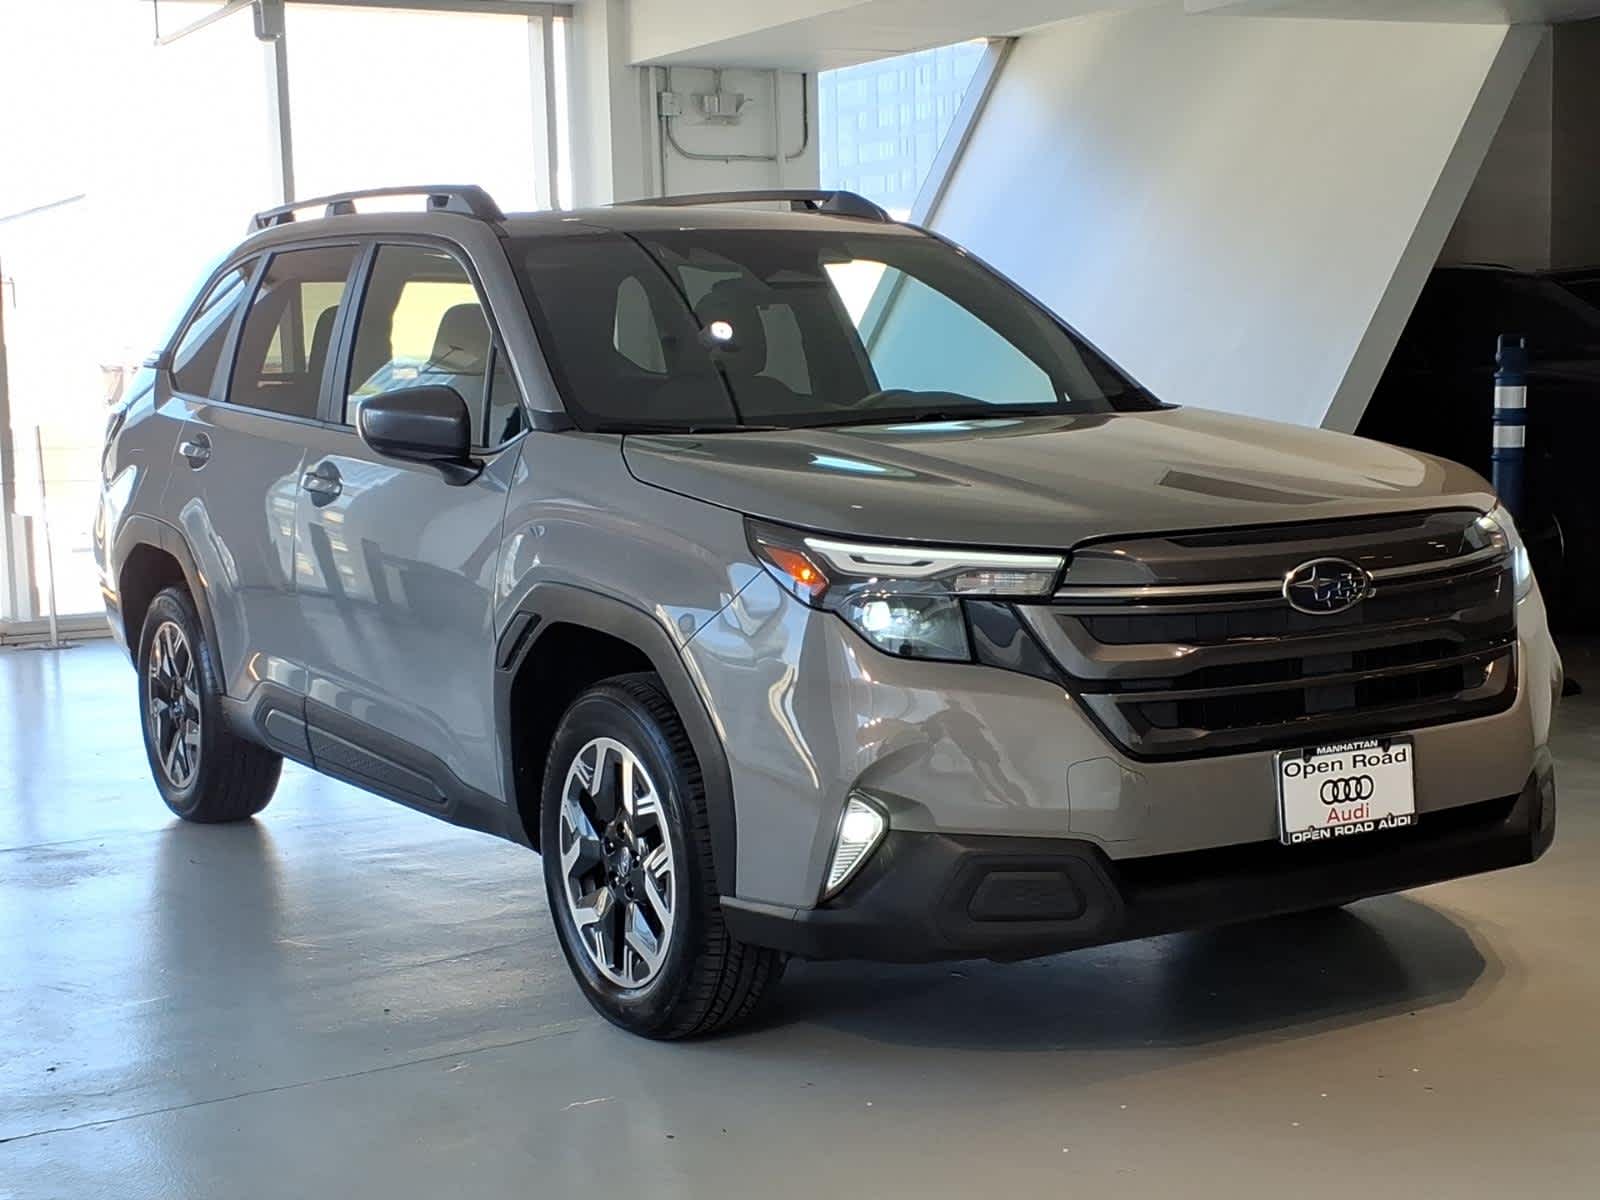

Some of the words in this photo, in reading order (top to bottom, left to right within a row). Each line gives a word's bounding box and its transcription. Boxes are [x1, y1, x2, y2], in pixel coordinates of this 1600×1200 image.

[1316, 740, 1378, 755] MANHATTAN
[1284, 760, 1343, 779] Open
[1352, 748, 1407, 768] Road
[1326, 803, 1370, 824] Audi
[1292, 828, 1331, 843] OPEN
[1335, 821, 1374, 836] ROAD
[1378, 816, 1411, 829] AUDI
